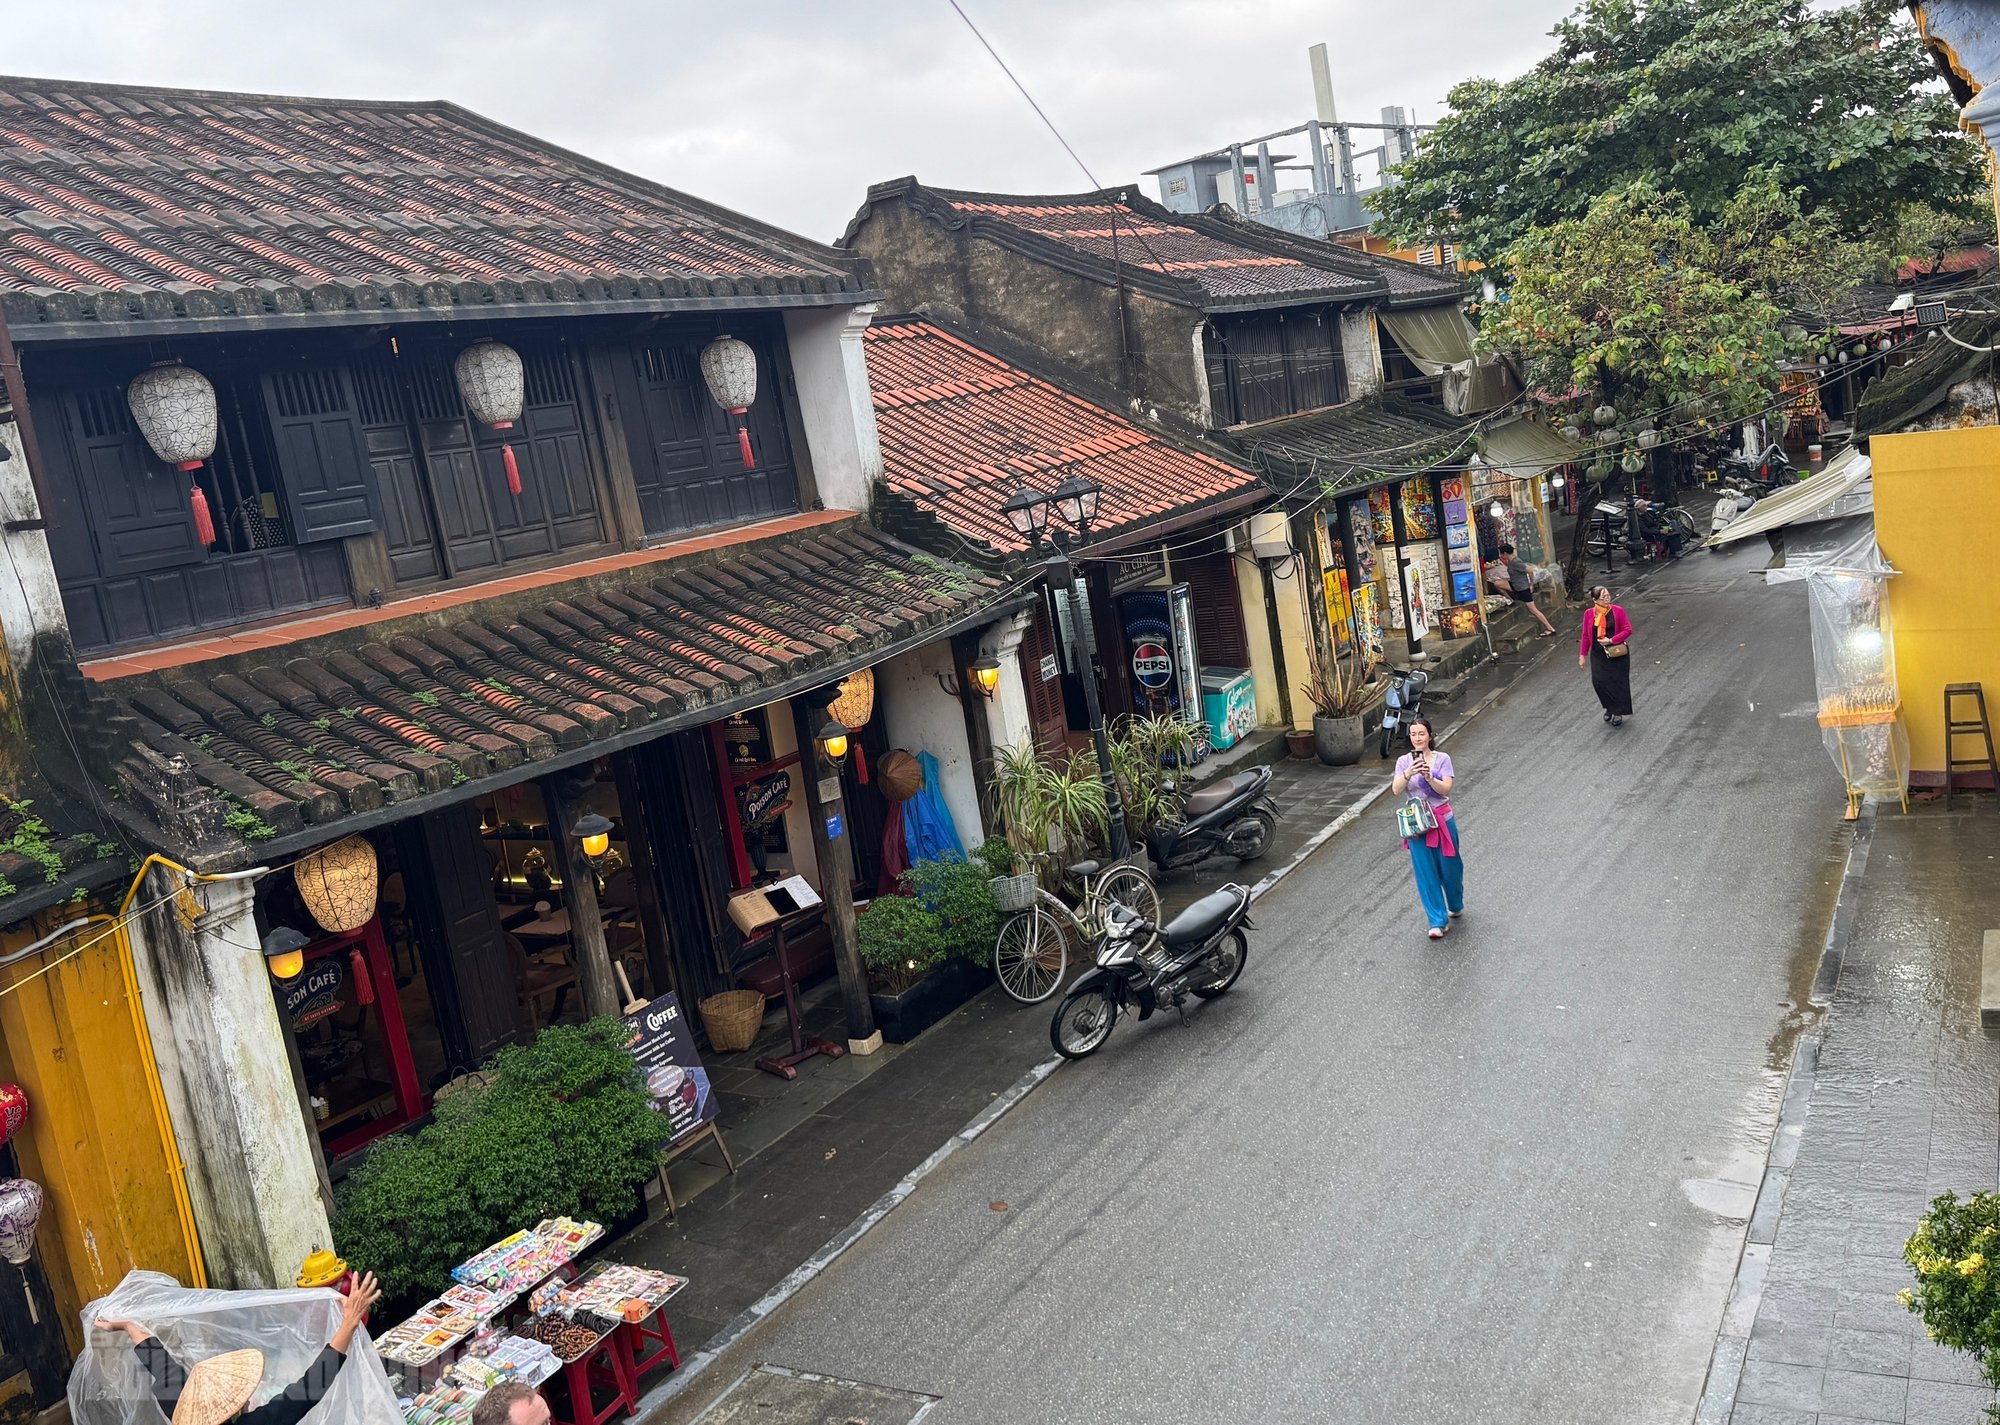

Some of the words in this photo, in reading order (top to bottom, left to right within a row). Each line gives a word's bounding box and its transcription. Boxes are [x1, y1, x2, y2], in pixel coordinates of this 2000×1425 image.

[1135, 661, 1170, 671] PEPSI
[749, 790, 772, 820] POISON
[772, 778, 788, 793] CAFÉ
[287, 985, 307, 1009] SON
[308, 969, 337, 992] CAFÉ
[647, 1006, 678, 1031] COFFEE
